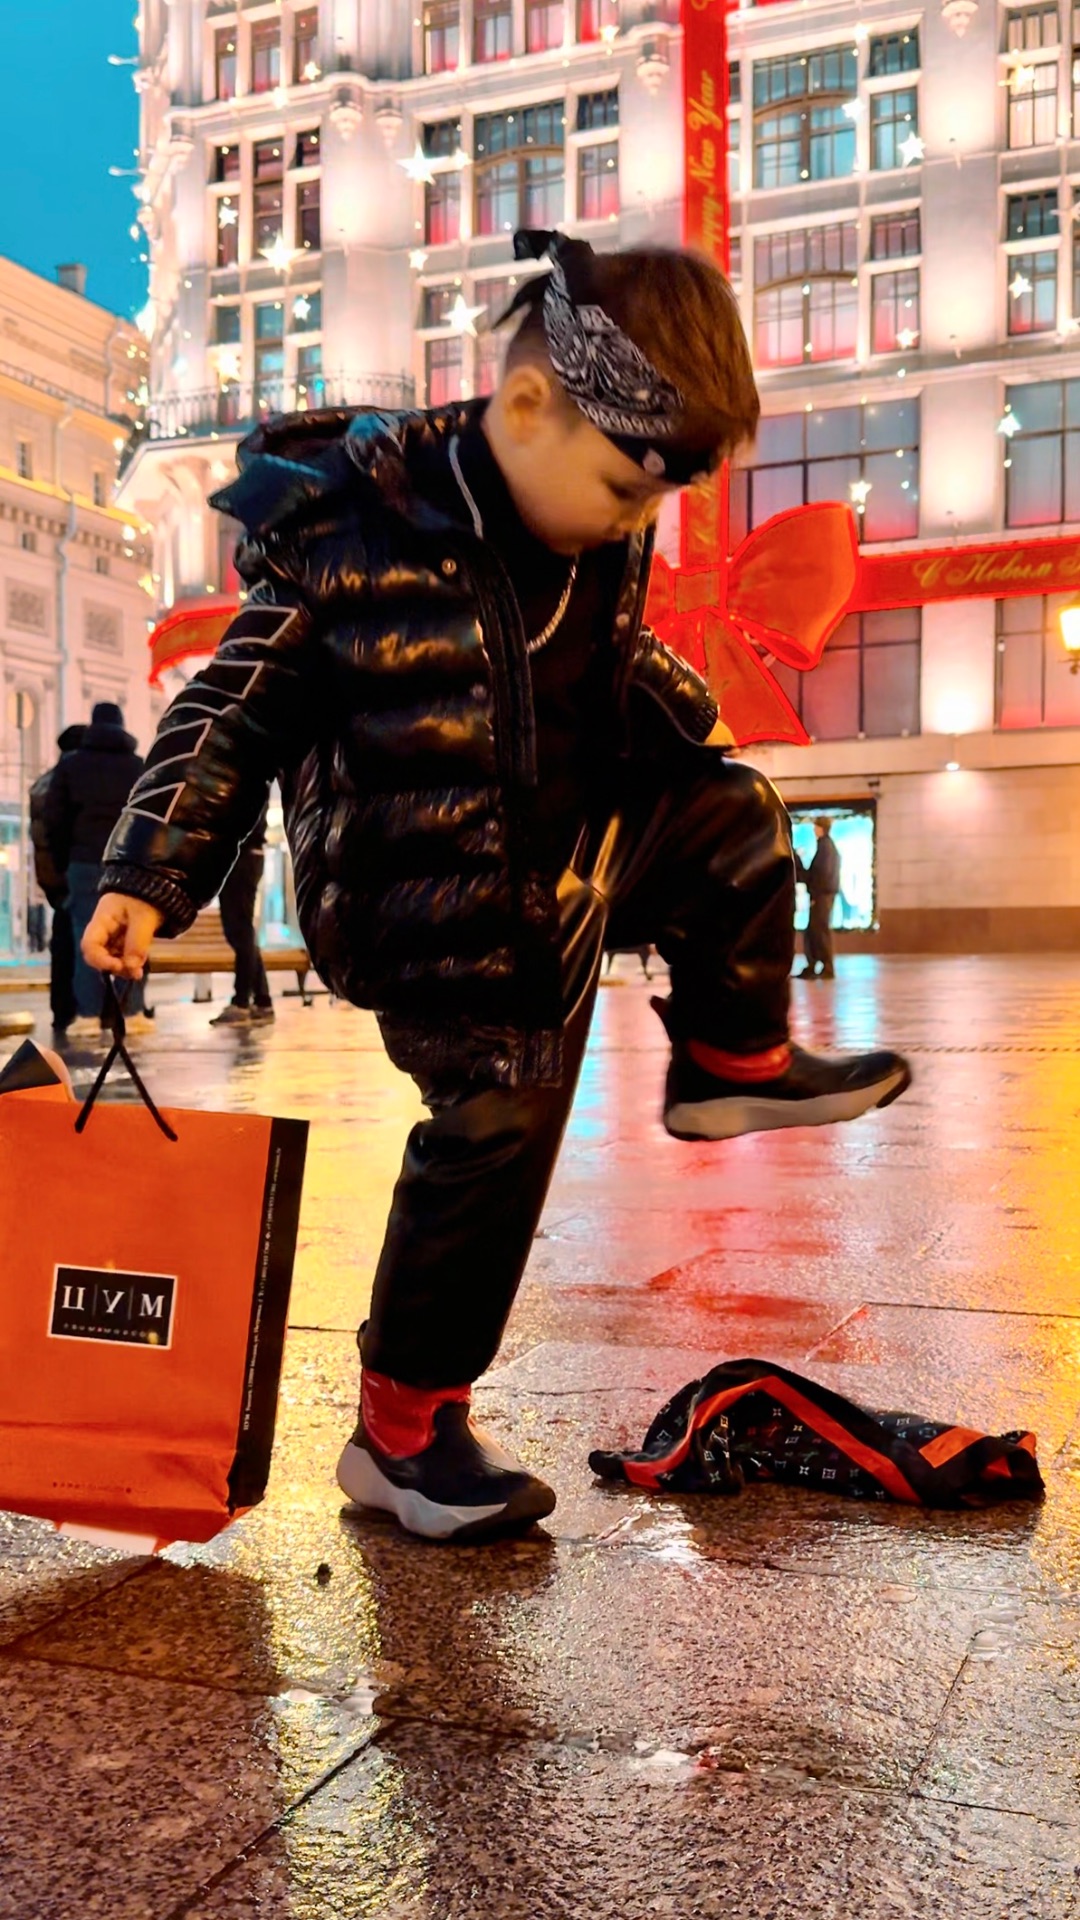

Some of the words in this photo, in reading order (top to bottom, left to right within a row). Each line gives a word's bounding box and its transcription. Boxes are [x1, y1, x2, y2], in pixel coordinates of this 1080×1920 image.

[688, 69, 723, 131] Year
[688, 138, 716, 195] New
[702, 196, 723, 251] appy
